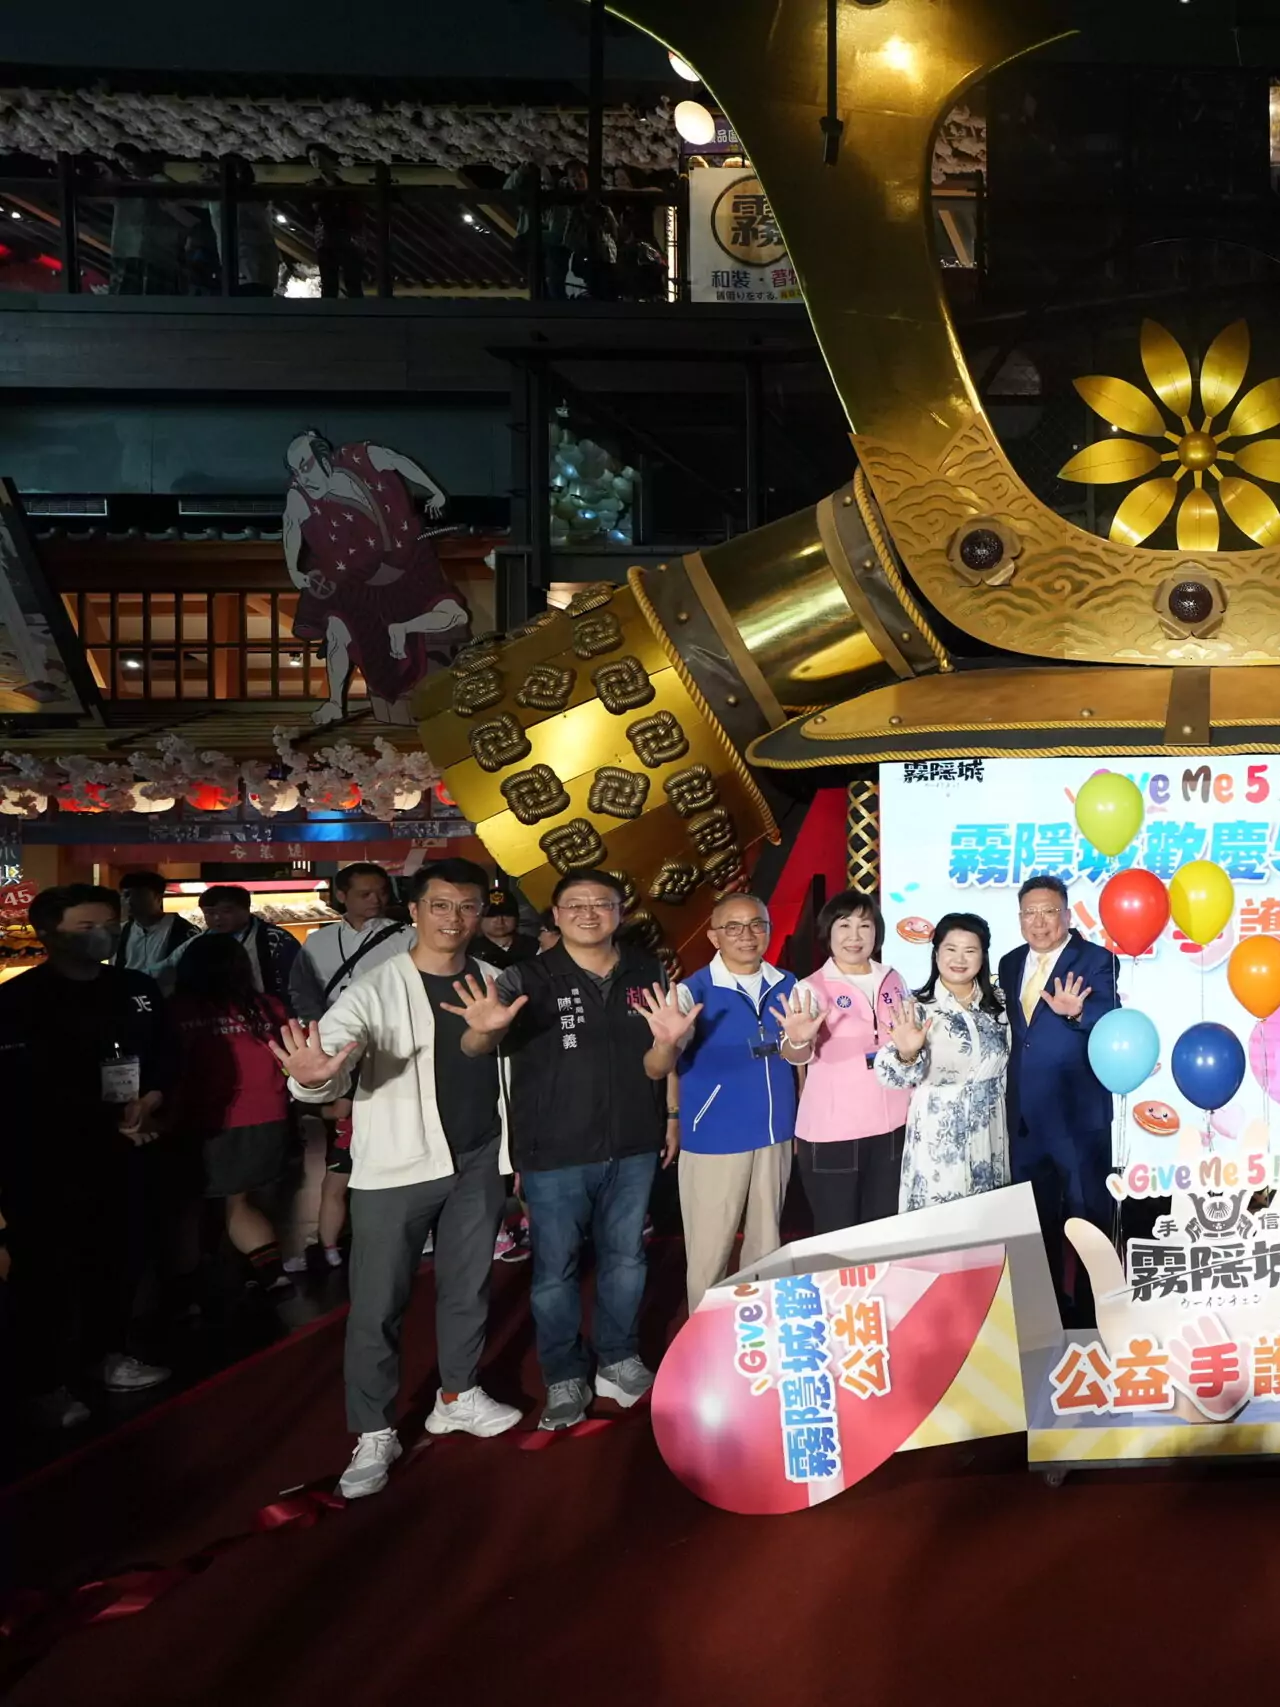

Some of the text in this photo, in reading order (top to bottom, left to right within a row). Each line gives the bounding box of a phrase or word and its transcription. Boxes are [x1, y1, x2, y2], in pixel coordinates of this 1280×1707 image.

[1181, 765, 1235, 804] Me
[4, 889, 33, 907] 45
[557, 997, 578, 1050] 陳冠義
[1128, 1162, 1192, 1194] Give
[1200, 1156, 1239, 1188] Me
[1157, 1211, 1280, 1237] 手 信
[737, 1304, 768, 1375] Give
